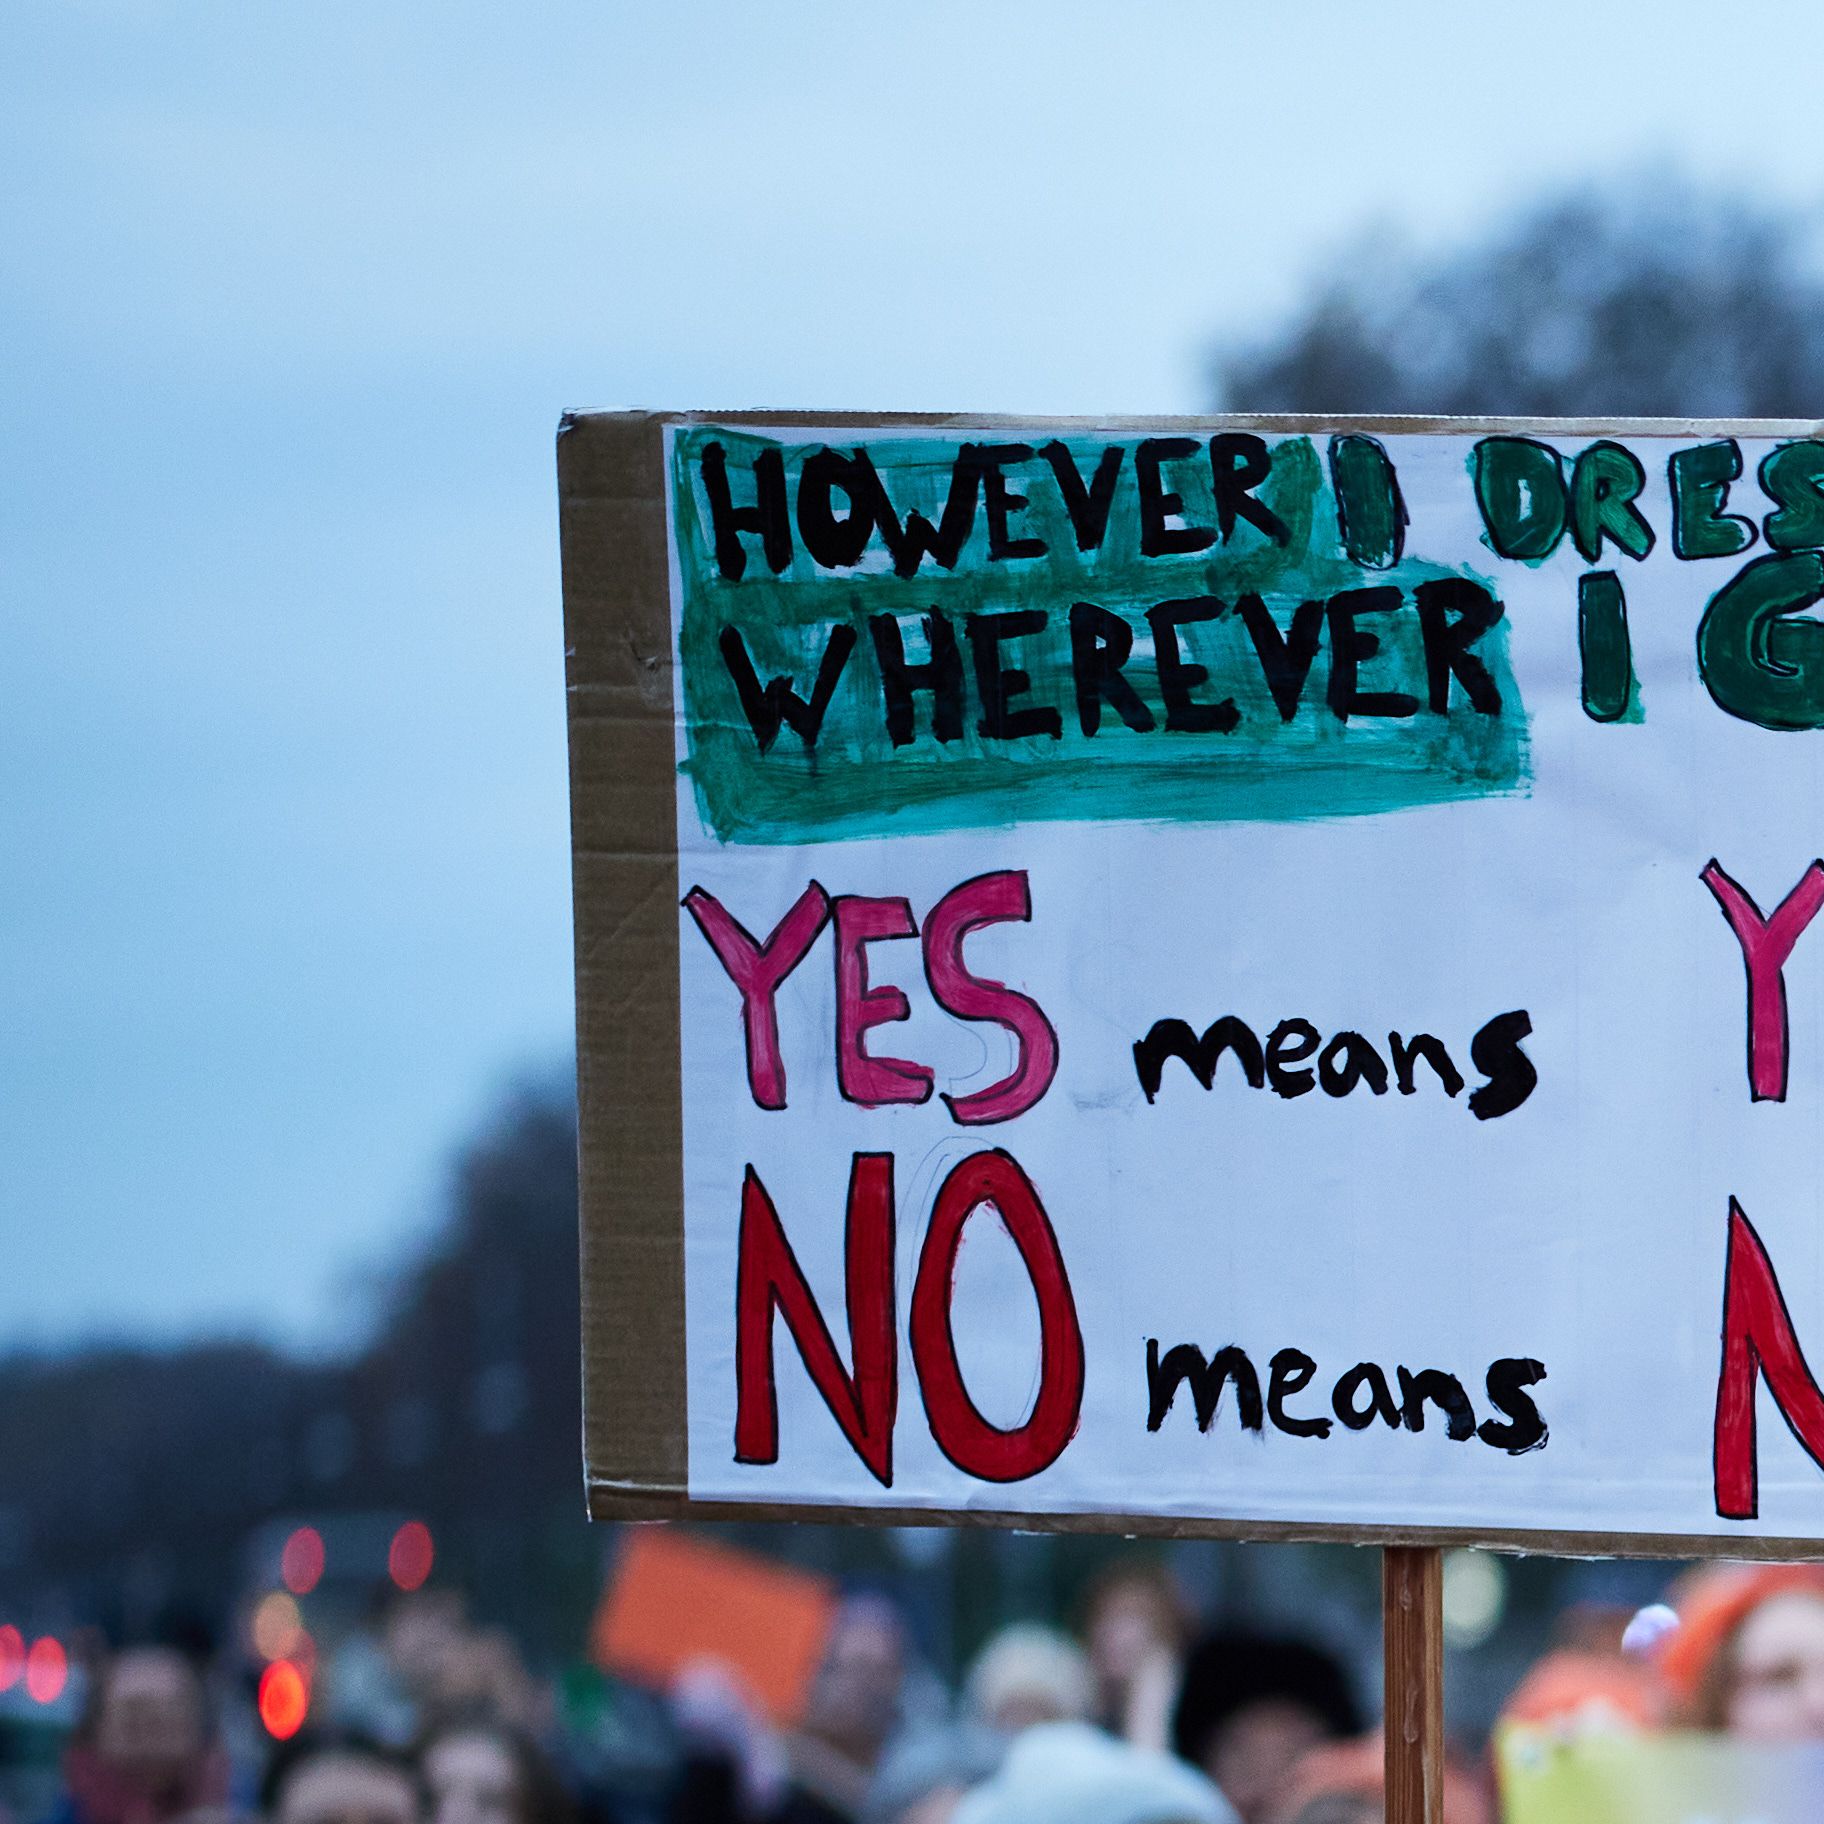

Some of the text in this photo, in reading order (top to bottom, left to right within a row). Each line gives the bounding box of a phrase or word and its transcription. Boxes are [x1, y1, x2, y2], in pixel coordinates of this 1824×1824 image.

[702, 432, 1292, 582] HOWEVER
[718, 574, 1505, 756] WHEREVER
[1577, 570, 1636, 724] I
[680, 868, 1060, 1127] YES
[1132, 1007, 1538, 1121] means
[733, 1146, 1085, 1489] NO
[1143, 1335, 1549, 1456] means
